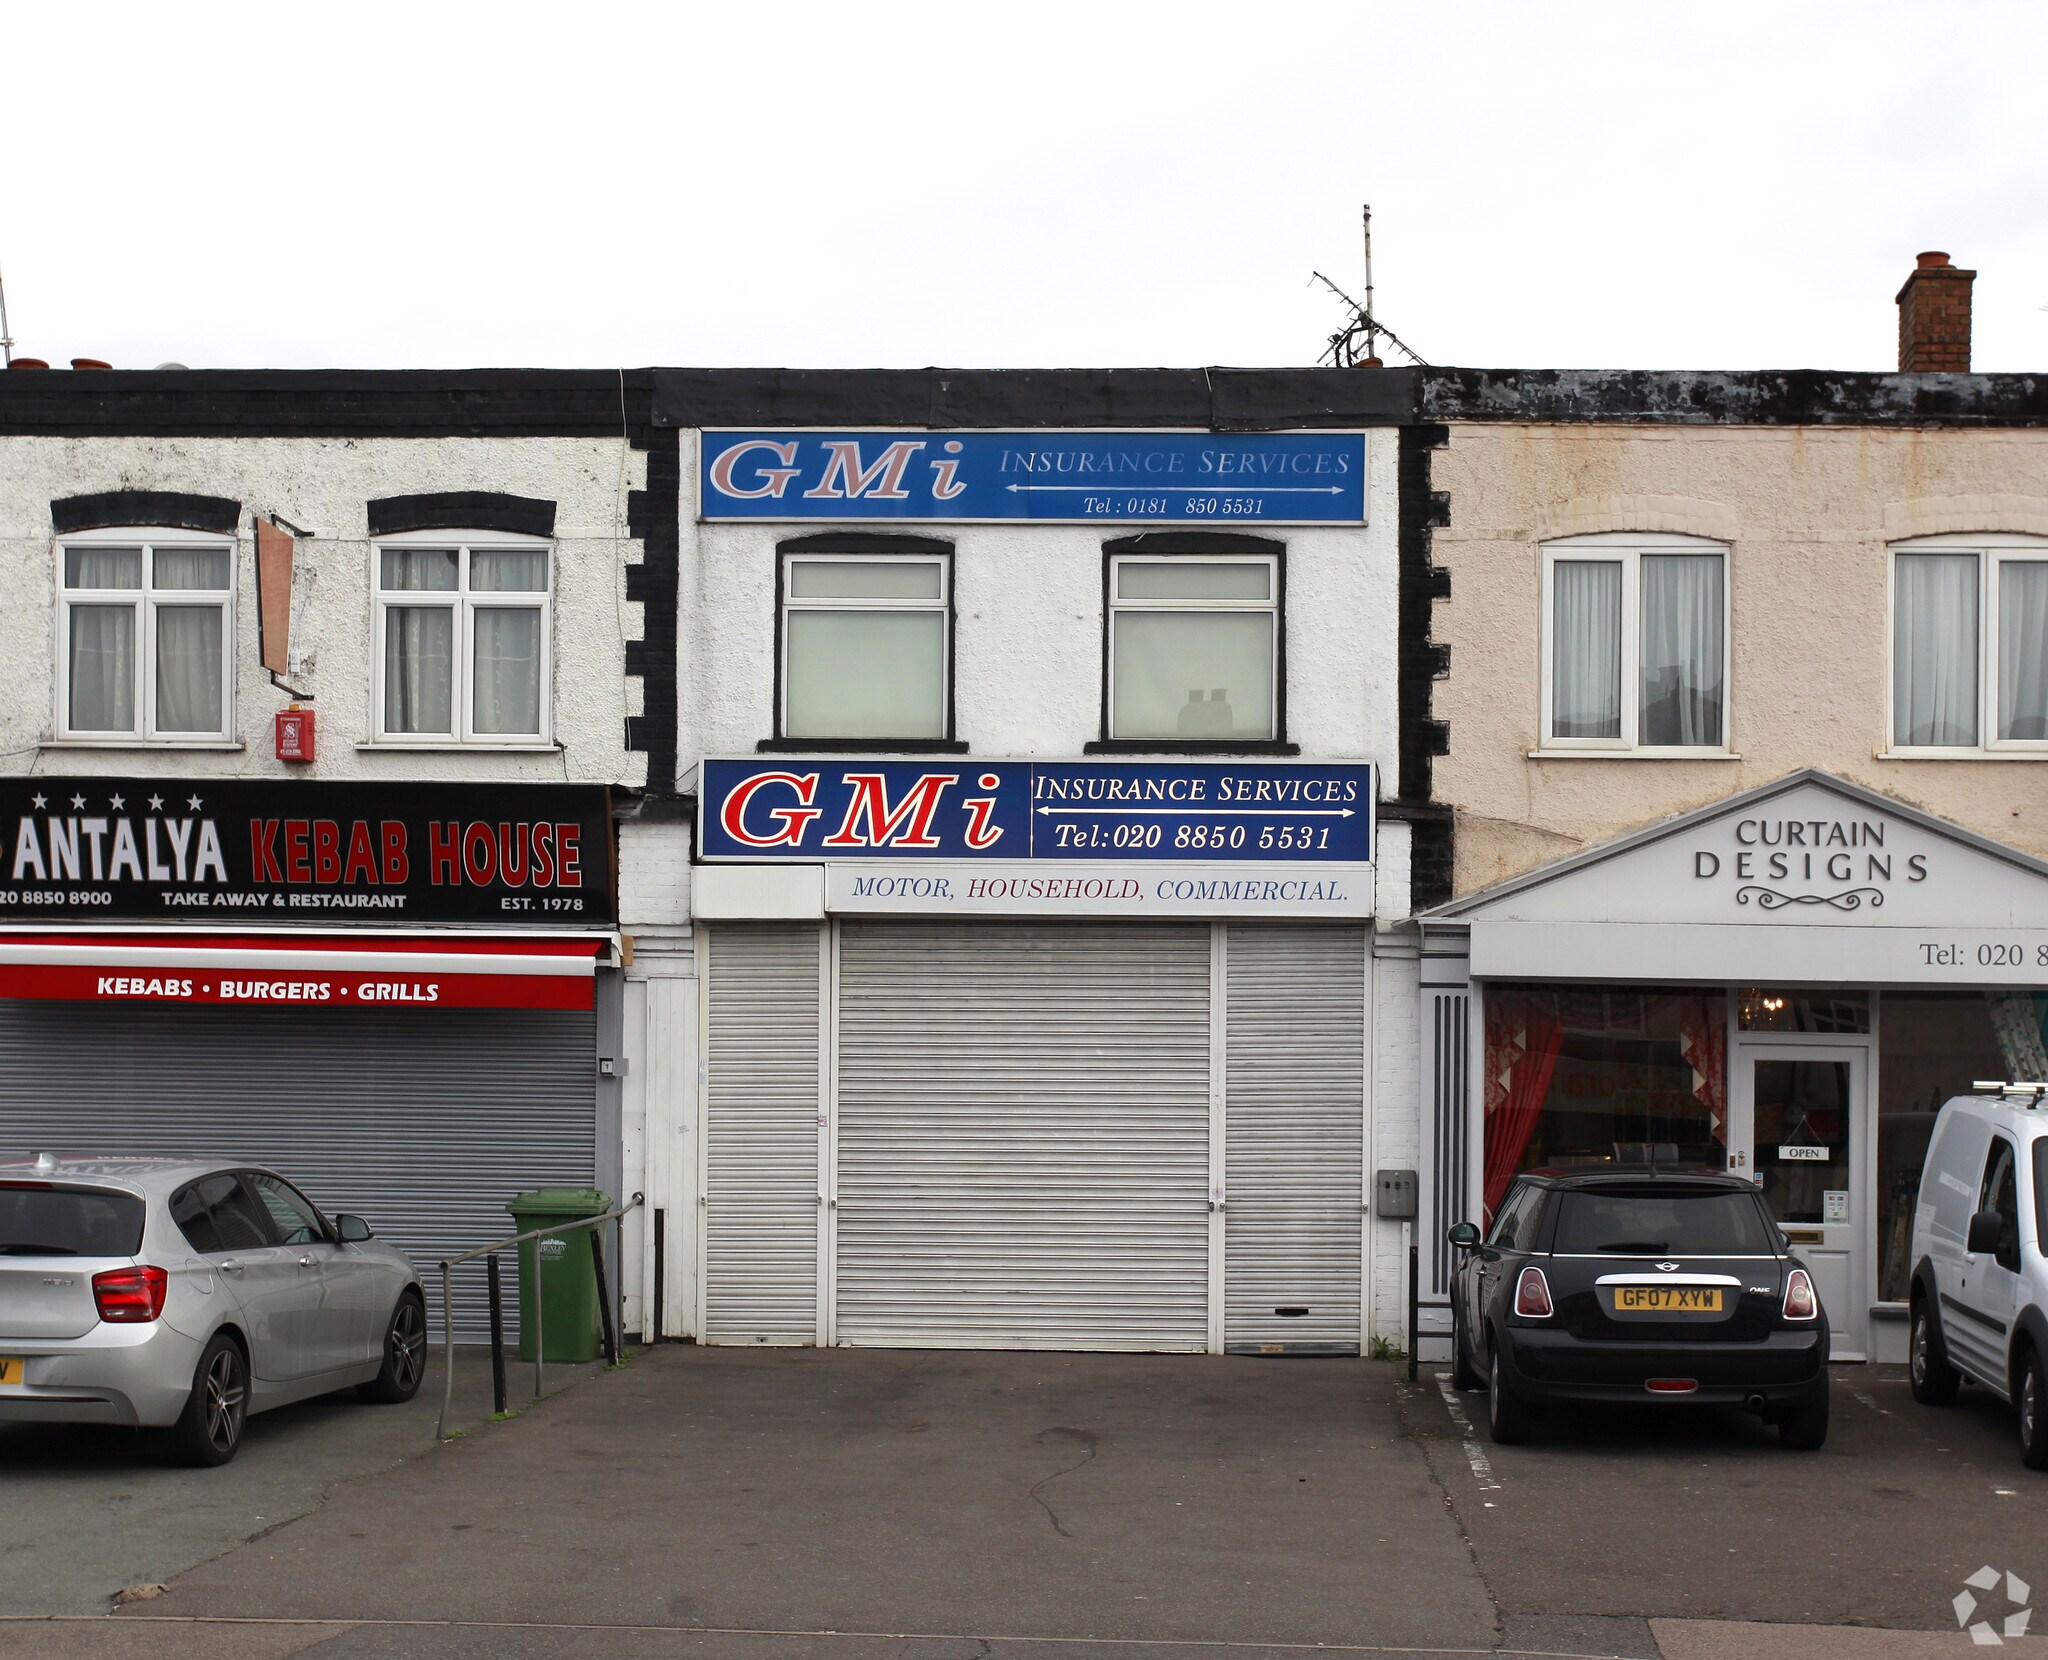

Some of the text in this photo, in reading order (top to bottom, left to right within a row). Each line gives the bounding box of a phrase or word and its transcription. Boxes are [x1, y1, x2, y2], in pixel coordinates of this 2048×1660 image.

[709, 440, 967, 499] GMi
[998, 449, 1350, 474] INSURANCE SERVICES
[1127, 498, 1166, 514] 0181
[1185, 498, 1218, 514] 850
[1221, 498, 1264, 514] 5531
[1034, 776, 1358, 803] INSURANCE SERVICES
[720, 772, 1004, 849] GMi
[1174, 825, 1246, 849] 8850
[1259, 827, 1330, 850] 5531
[1736, 820, 1884, 846] CURTAIN
[13, 816, 582, 888] ANTALYA KEBAB HOUSE
[1695, 851, 1928, 882] DESIGNS
[22, 891, 65, 905] 8850
[69, 892, 112, 905] 8900
[163, 892, 407, 909] TAKE AWAY & RESTAURANT
[852, 878, 1349, 902] MOTOR, HOUSEHOLD, COMMERCIAL.
[502, 898, 584, 911] EST. 1978
[1920, 944, 1965, 965] Tel:
[1977, 944, 2023, 966] 020
[97, 977, 439, 1002] KEBABS BURGERS GRILLS
[1788, 1148, 1820, 1158] OPEN
[1623, 1289, 1714, 1307] GF07 XYW
